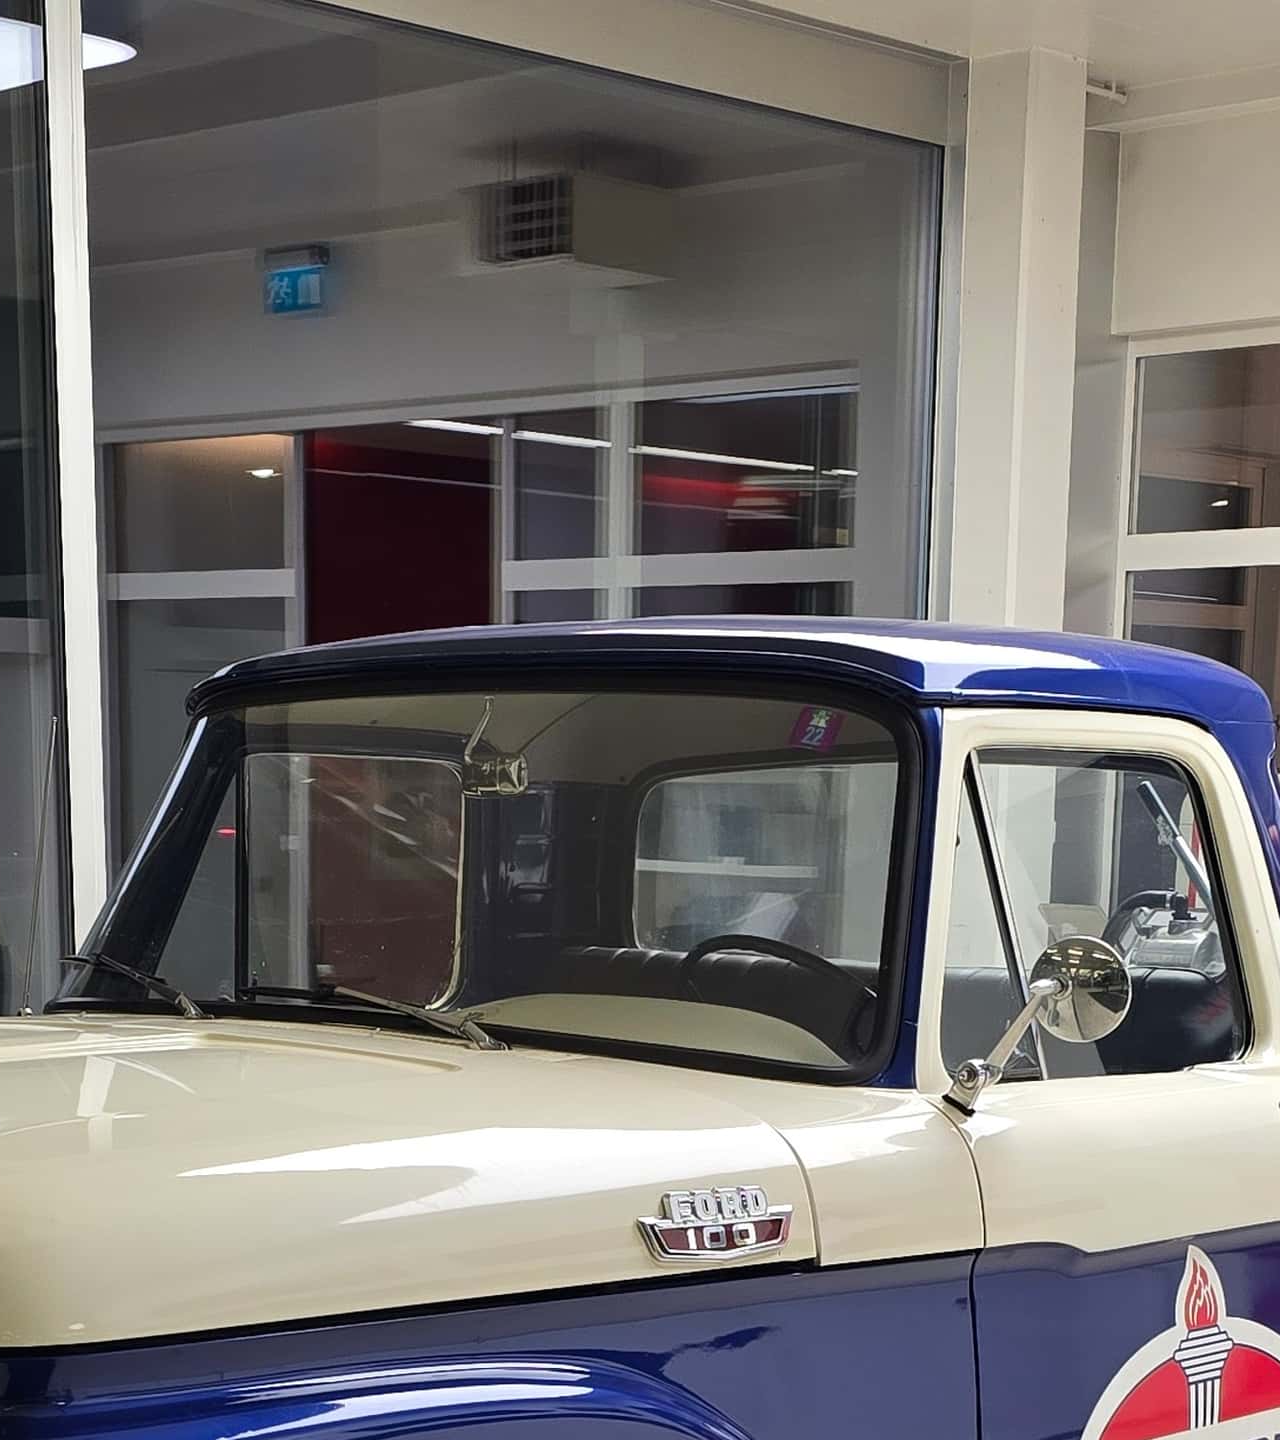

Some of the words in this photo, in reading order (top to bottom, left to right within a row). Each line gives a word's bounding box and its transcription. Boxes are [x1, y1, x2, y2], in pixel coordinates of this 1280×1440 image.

[801, 726, 825, 745] 22
[663, 1186, 768, 1224] FORD
[687, 1222, 757, 1250] 100
